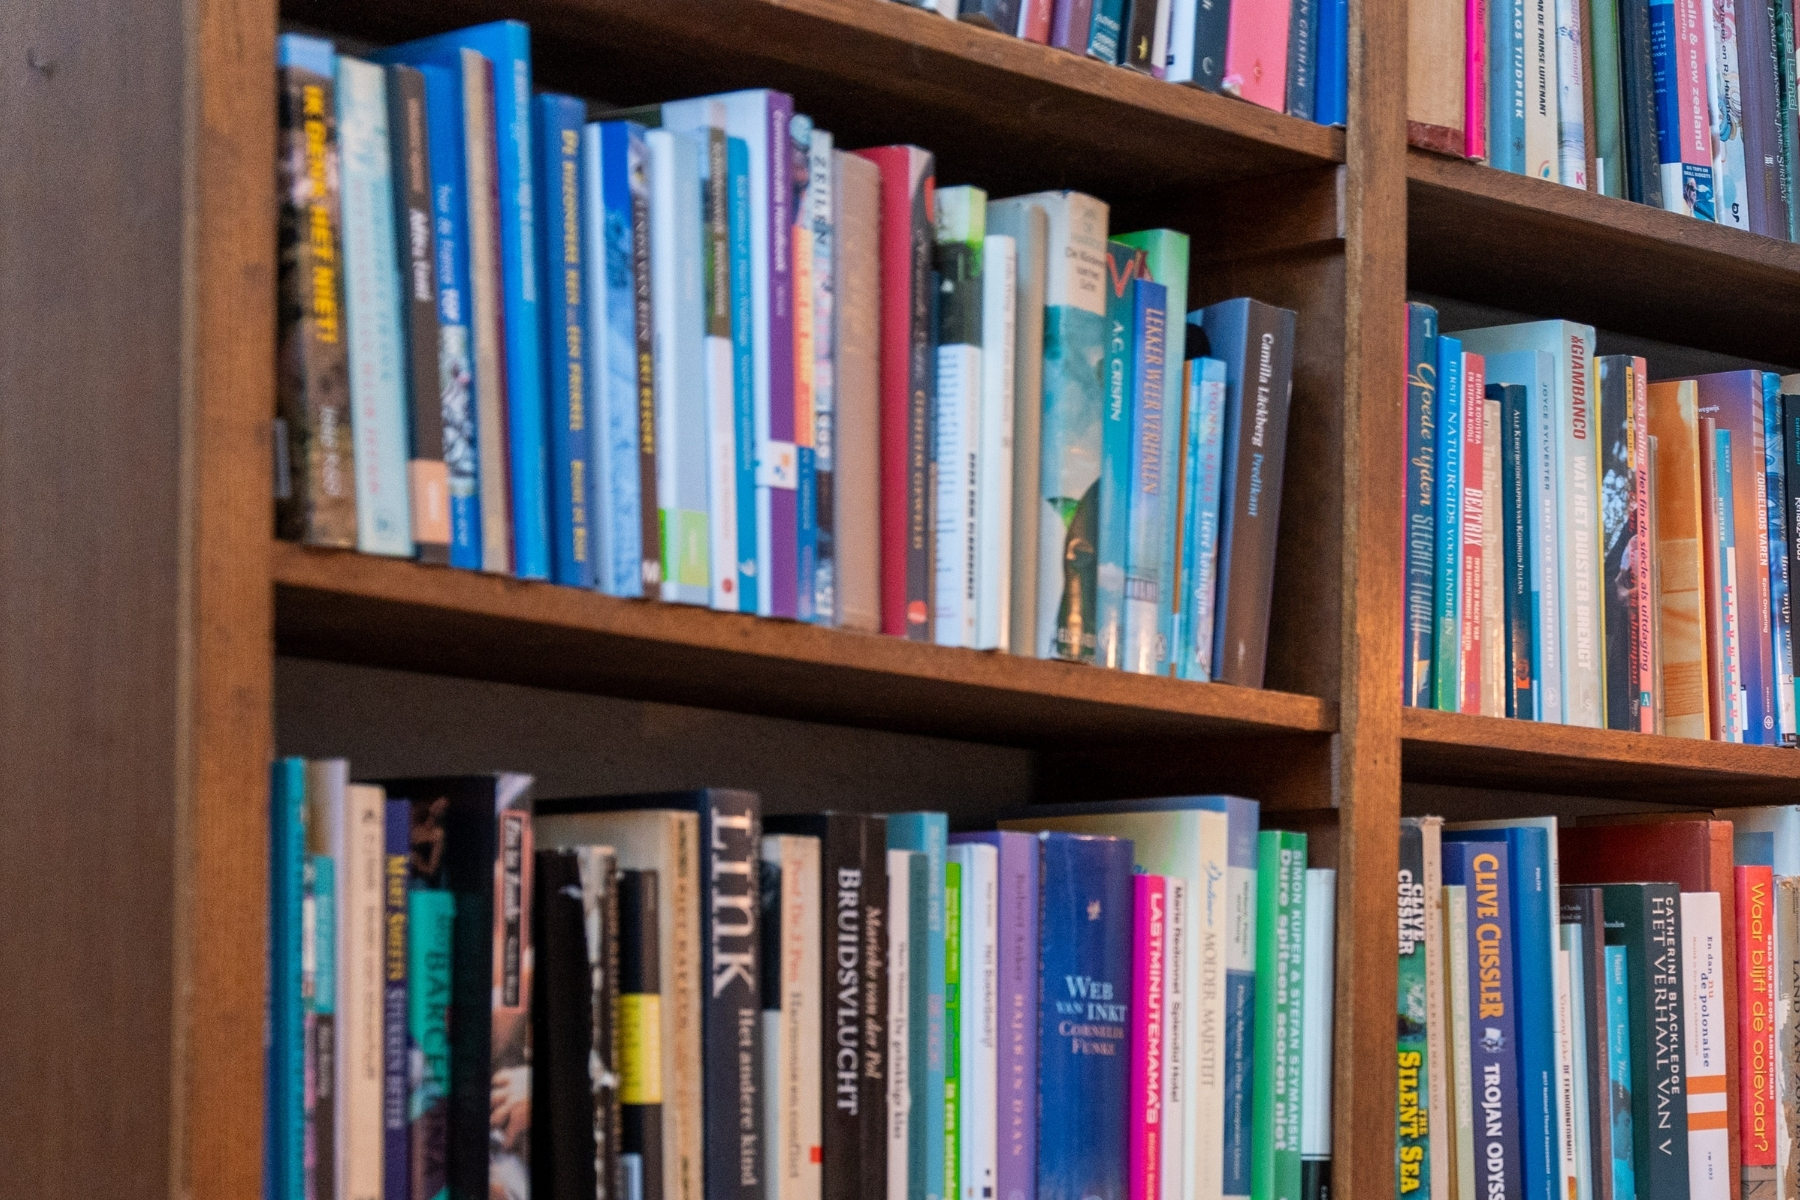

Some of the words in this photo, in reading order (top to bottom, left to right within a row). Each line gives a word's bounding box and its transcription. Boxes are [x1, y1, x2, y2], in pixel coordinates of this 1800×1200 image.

[1538, 13, 1544, 25] DE
[1689, 33, 1698, 45] &
[1296, 19, 1308, 88] GRISHAM
[1690, 50, 1700, 84] new
[1693, 88, 1705, 151] zealand
[773, 109, 788, 204] Communicatie
[310, 207, 332, 263] HET
[775, 208, 788, 272] Handboek
[1112, 320, 1125, 355] A.C.
[1145, 308, 1165, 364] LEKKER
[1258, 332, 1275, 384] Camilla
[1110, 358, 1123, 421] CRISPIN
[1143, 367, 1163, 409] WEER
[1409, 363, 1436, 449] Goede
[1571, 344, 1586, 440] GIAMBANCO
[1636, 373, 1646, 401] Kees
[1252, 386, 1270, 446] Läckberg
[1635, 420, 1647, 465] Paling
[1140, 413, 1162, 493] VERHALEN
[1409, 451, 1434, 506] tijden
[1573, 456, 1587, 491] WAT
[1247, 452, 1264, 517] Predikant
[1638, 470, 1647, 495] Het
[1640, 497, 1648, 515] fin
[1757, 472, 1766, 529] ZORGELOOS
[1464, 487, 1482, 546] BEATRIX
[1574, 495, 1587, 527] HET
[1640, 518, 1648, 536] de
[1575, 531, 1589, 601] DUISTER
[1640, 540, 1649, 573] siècle
[1759, 533, 1768, 565] VAREN
[1640, 576, 1649, 602] als
[1577, 605, 1591, 670] BRENGT
[1640, 605, 1652, 672] uitdaging
[1278, 850, 1292, 909] Dure
[1290, 850, 1303, 904] SIMON
[1290, 910, 1302, 966] KUPER
[1652, 897, 1667, 947] HET
[1665, 897, 1677, 985] CATHERINE
[1750, 884, 1764, 943] Waar
[864, 907, 882, 978] Marieke
[1275, 915, 1291, 1008] spitsen
[865, 981, 880, 1013] van
[1289, 970, 1301, 983] &
[1751, 950, 1768, 993] blijft
[738, 1008, 756, 1046] Het
[866, 1016, 882, 1046] der
[1288, 988, 1300, 1050] STEFAN
[1654, 954, 1670, 1072] VERHAAL
[1752, 1002, 1766, 1032] de
[864, 1050, 882, 1079] Pol
[1275, 1013, 1288, 1097] scoren
[1669, 992, 1680, 1095] BLACKLEDGE
[738, 1052, 756, 1129] andere
[1287, 1055, 1300, 1152] SZYMANSKI
[1482, 1063, 1503, 1137] TROJAN
[1657, 1080, 1671, 1129] VAN
[1753, 1039, 1769, 1152] ooievaar?
[1274, 1102, 1288, 1151] niet
[1418, 1109, 1428, 1134] THE
[1659, 1137, 1672, 1155] V
[740, 1134, 757, 1185] kind
